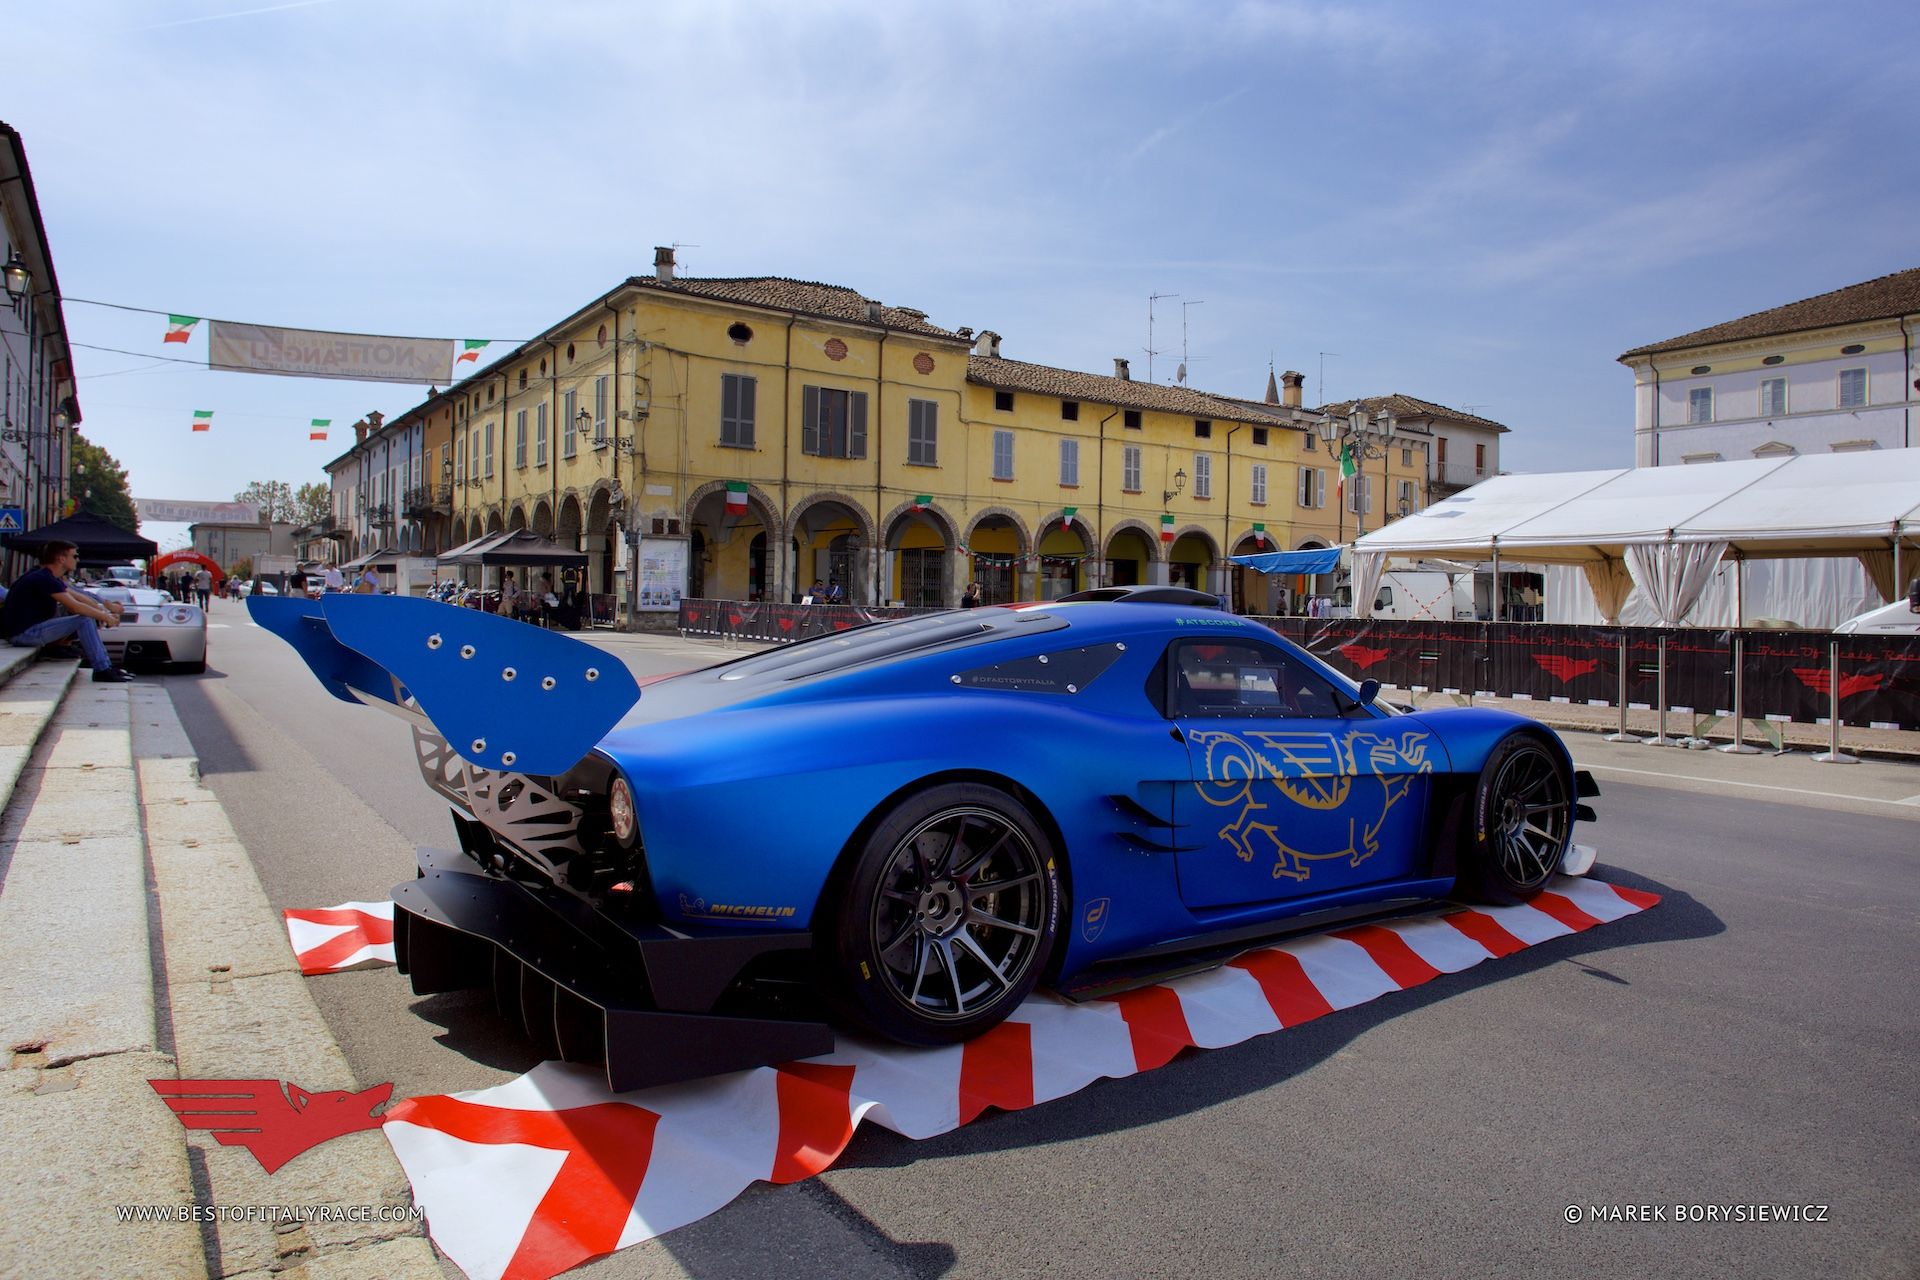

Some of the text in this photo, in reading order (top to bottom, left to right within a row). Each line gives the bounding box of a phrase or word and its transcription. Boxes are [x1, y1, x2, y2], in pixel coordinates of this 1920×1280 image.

[1758, 645, 1800, 656] Best
[1800, 646, 1825, 659] Of
[710, 903, 796, 917] MICHELIN
[1049, 878, 1058, 933] MICHELIN
